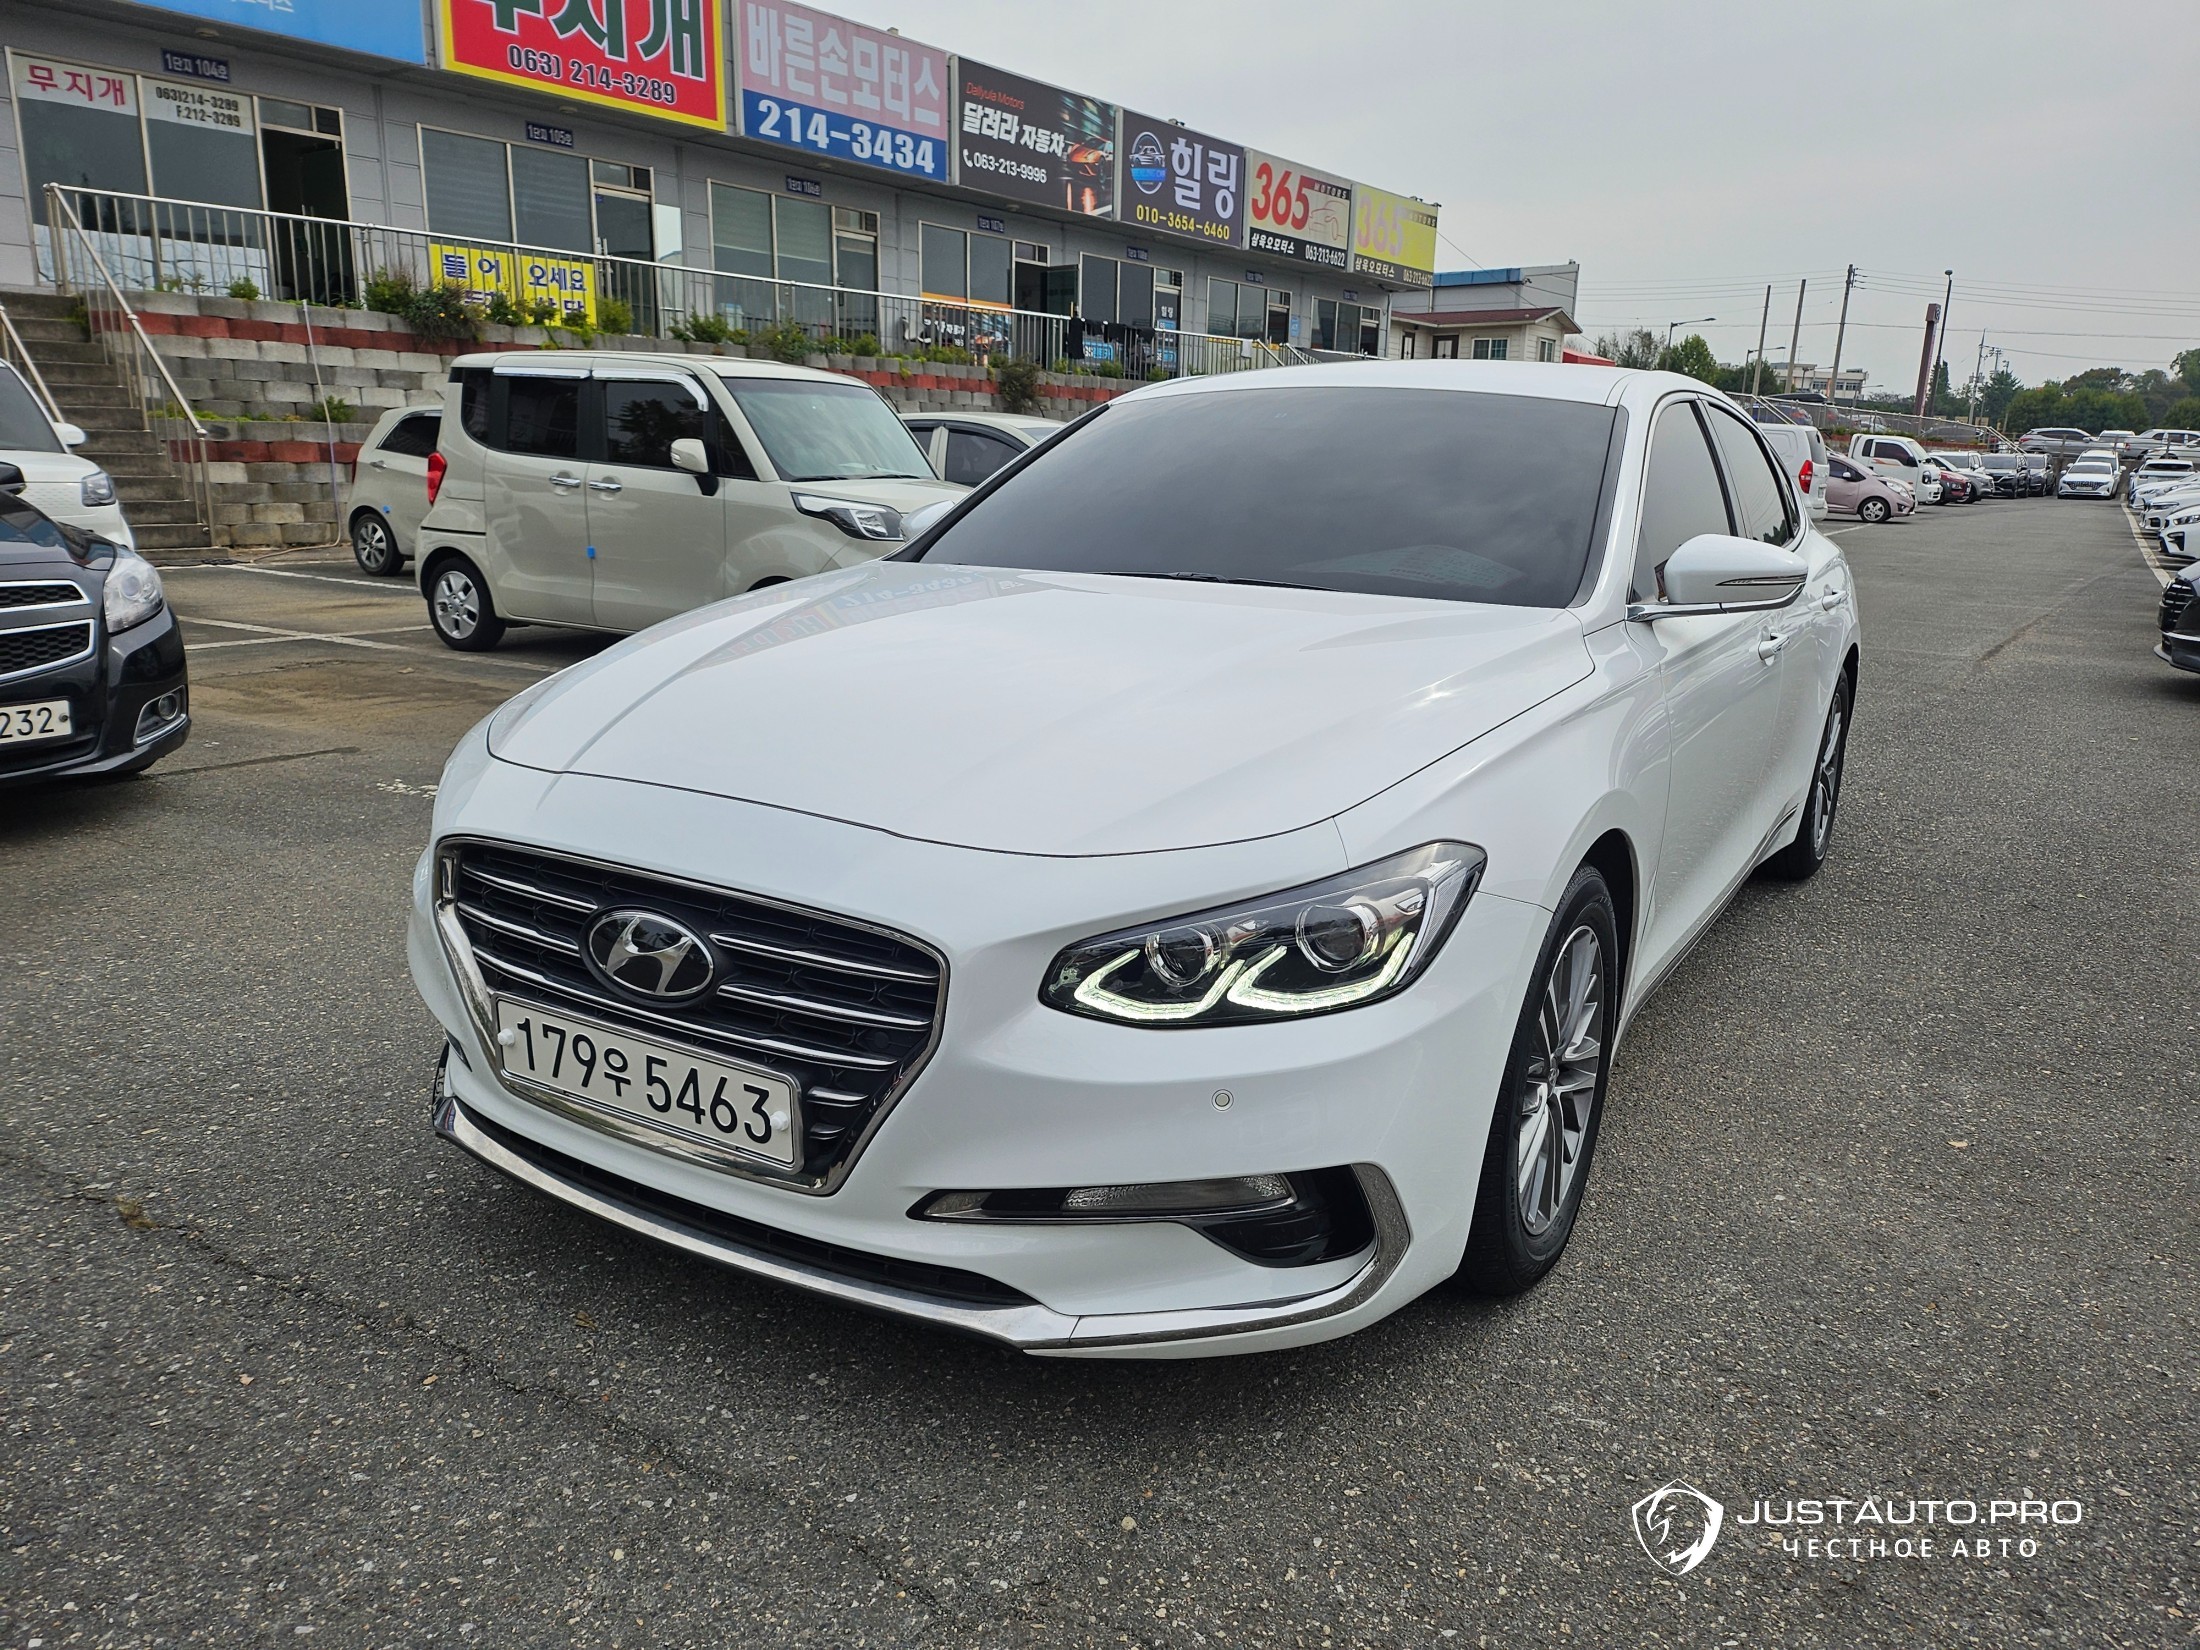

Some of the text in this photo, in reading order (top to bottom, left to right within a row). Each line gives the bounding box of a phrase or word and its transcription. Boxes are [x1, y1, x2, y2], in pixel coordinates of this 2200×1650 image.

[27, 64, 126, 107] 무지개
[165, 53, 229, 80] 1단지 104호
[507, 44, 677, 104] 063) 214-3289
[746, 3, 940, 127] 바른손모터스
[757, 99, 936, 175] 214-3434
[962, 101, 1066, 158] 달려라 자동차
[973, 151, 1048, 183] 063-213-9996
[1169, 136, 1239, 220] 힐링
[1251, 161, 1312, 231] 365
[1314, 181, 1347, 199] MOTORS
[1136, 203, 1231, 240] 010-3654-6460
[1251, 232, 1295, 254] 삼육오모터스
[1357, 193, 1404, 257] 365
[1304, 244, 1346, 268] 063-213-6622
[1355, 257, 1396, 278] 삼육오모터스
